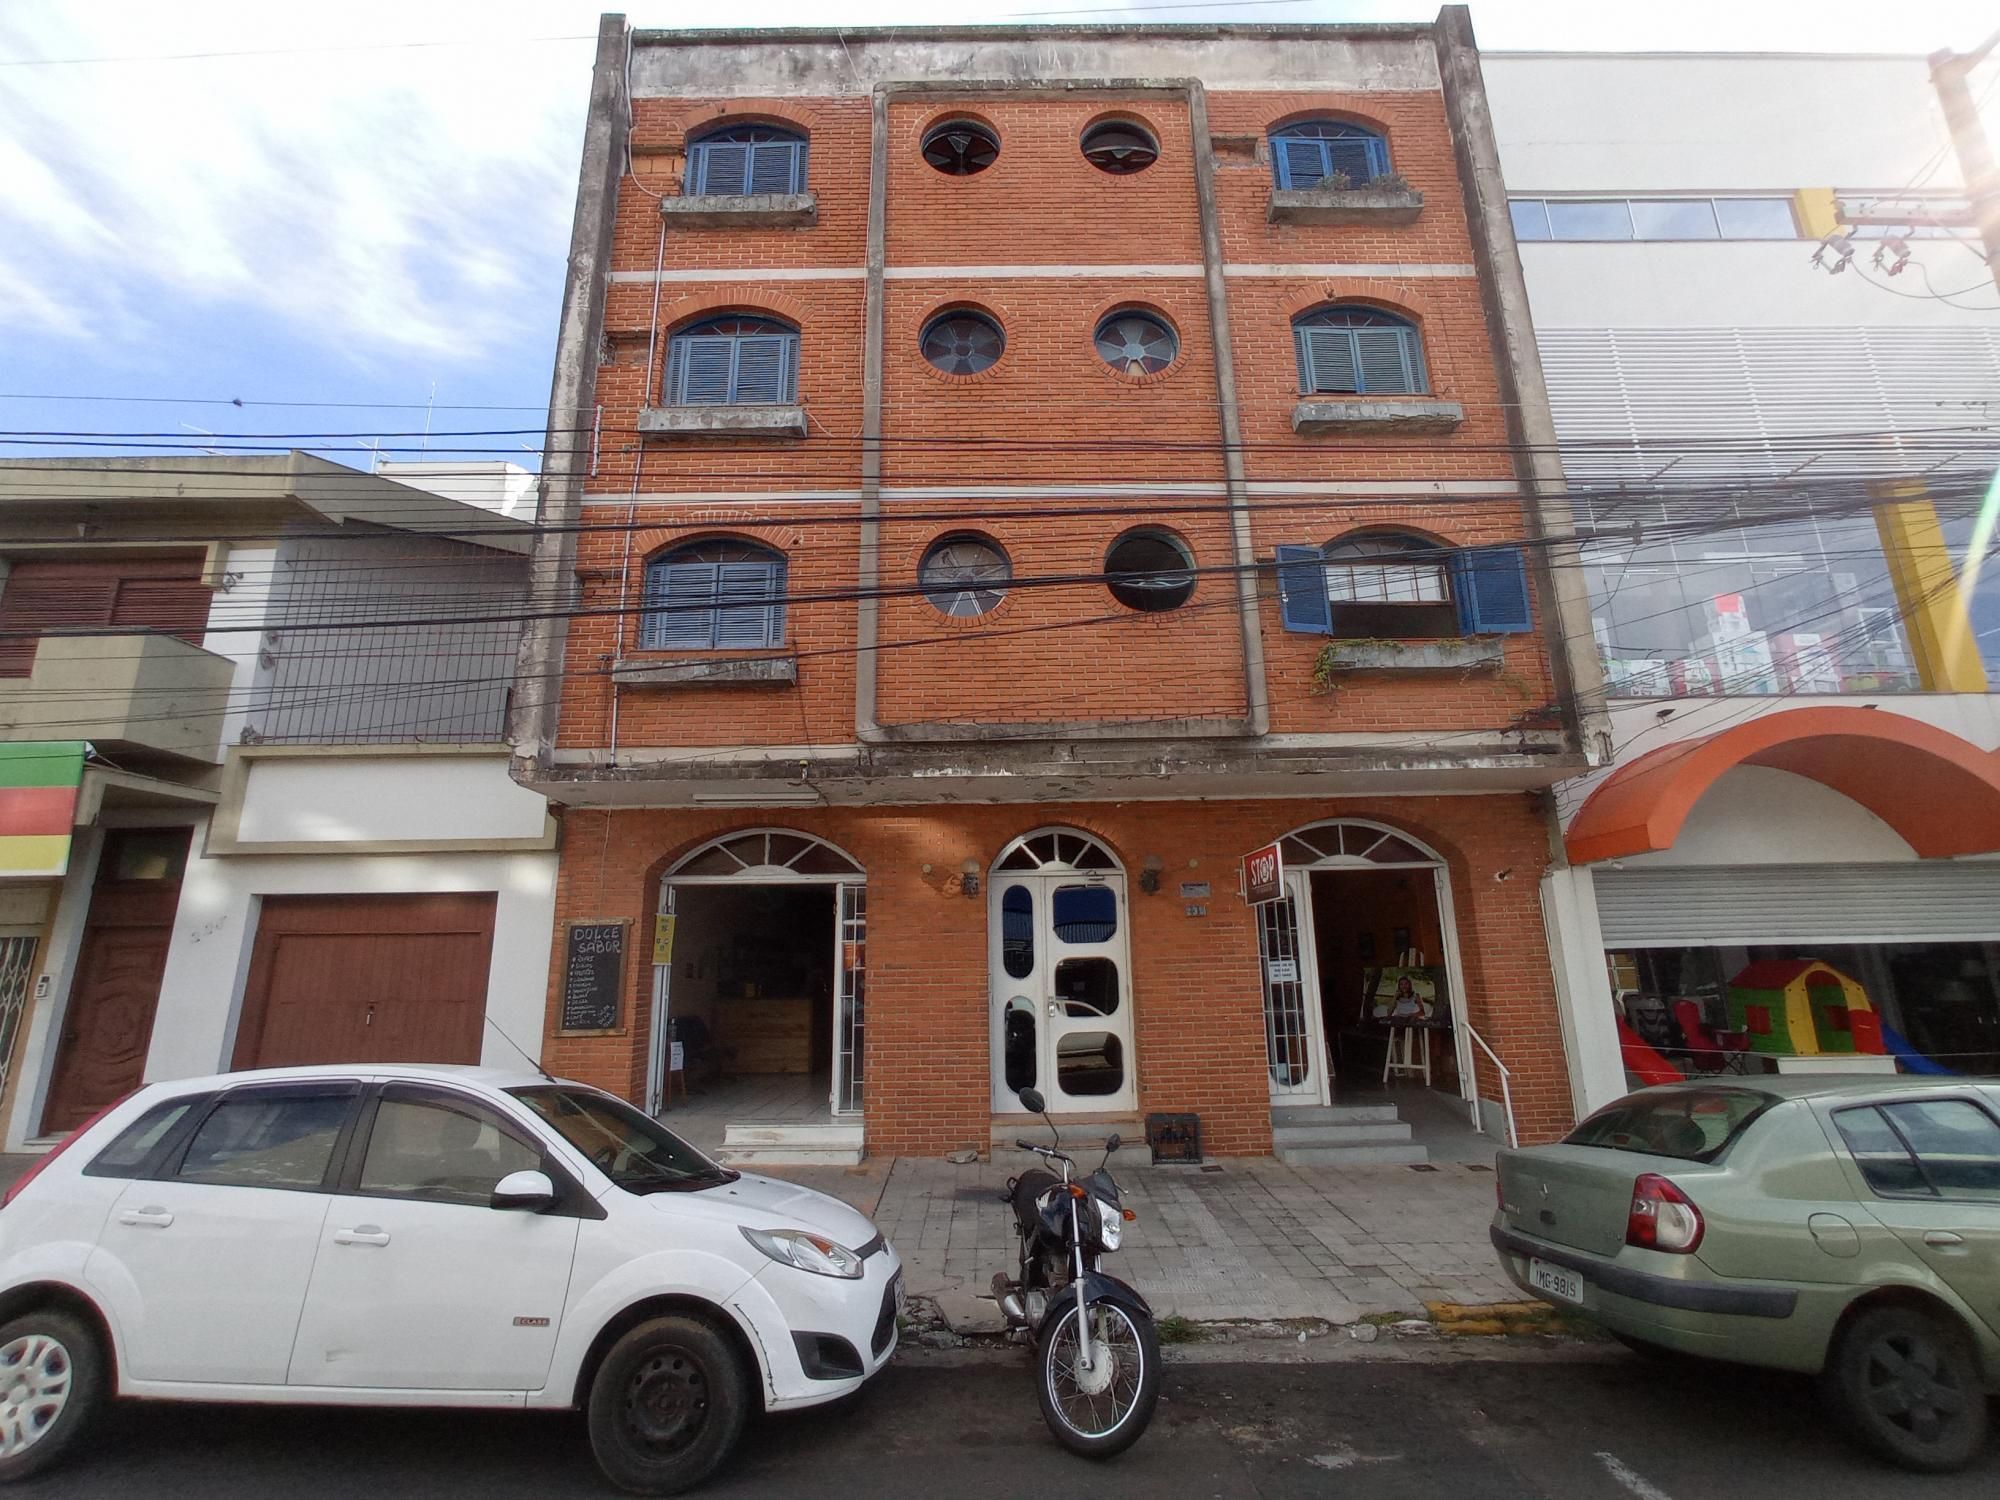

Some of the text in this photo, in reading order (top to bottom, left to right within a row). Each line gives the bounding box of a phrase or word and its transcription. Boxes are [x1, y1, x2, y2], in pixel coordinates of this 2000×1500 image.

[1250, 854, 1274, 886] STOP
[574, 927, 619, 942] DOLCE
[577, 940, 620, 953] SABOR
